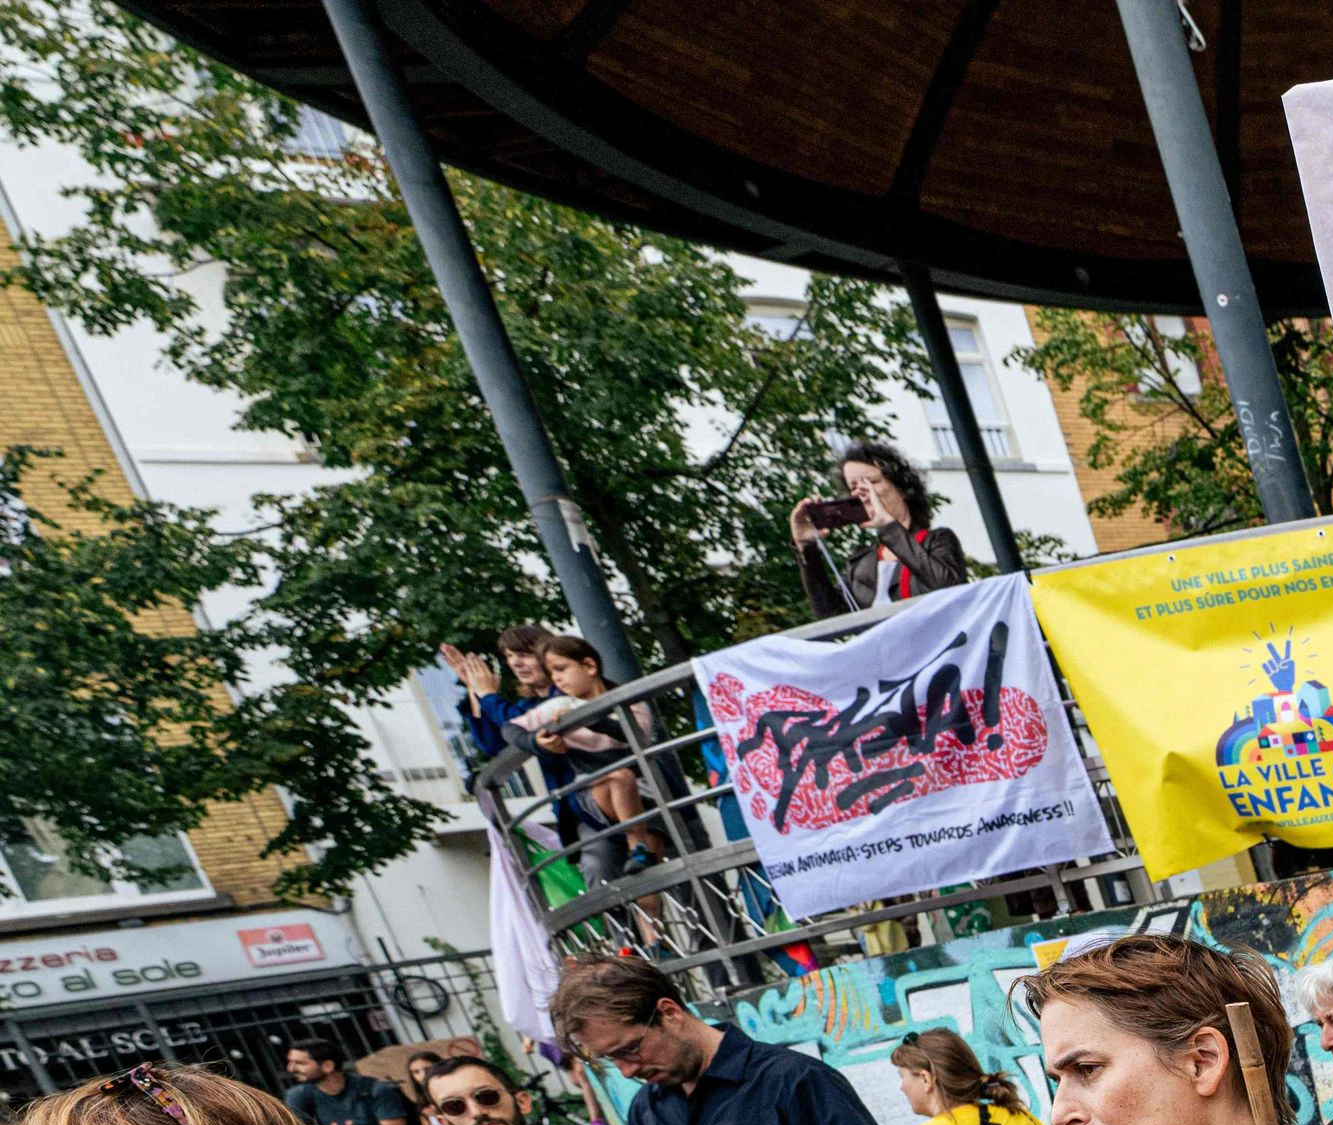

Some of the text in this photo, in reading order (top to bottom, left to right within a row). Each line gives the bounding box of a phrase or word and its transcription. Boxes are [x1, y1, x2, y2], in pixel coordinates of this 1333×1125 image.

[1170, 575, 1204, 593] UNE
[1207, 566, 1248, 586] VILLE
[1252, 561, 1290, 580] PLUS
[1135, 605, 1153, 621] ET
[1156, 599, 1193, 617] PLUS
[1196, 588, 1236, 609] SÛRE
[1238, 584, 1282, 603] POUR
[1284, 578, 1319, 596] NOS
[1219, 769, 1252, 790] LA
[1256, 758, 1326, 783] VILLE
[861, 836, 904, 860] STEPS
[905, 823, 974, 849] TOWARDS
[61, 967, 98, 993] al
[112, 957, 204, 987] sole
